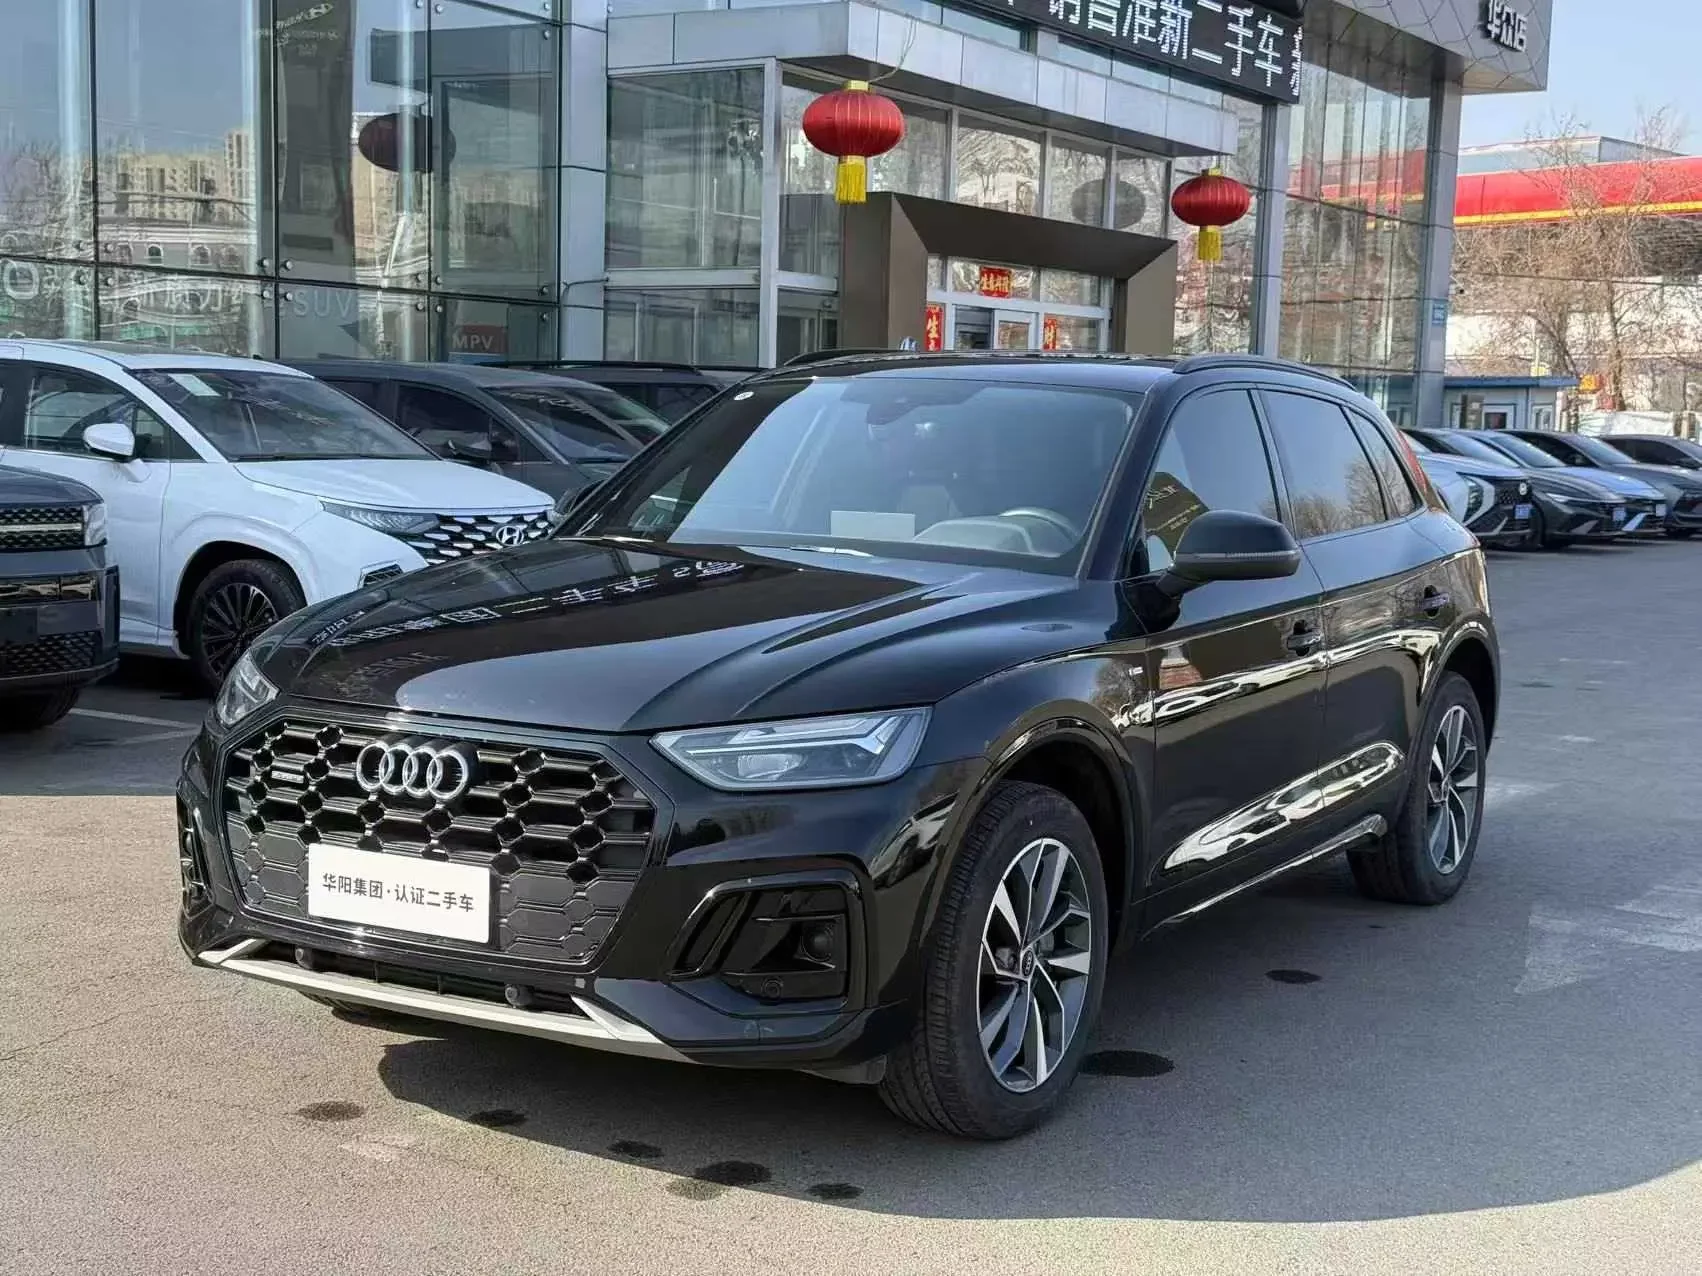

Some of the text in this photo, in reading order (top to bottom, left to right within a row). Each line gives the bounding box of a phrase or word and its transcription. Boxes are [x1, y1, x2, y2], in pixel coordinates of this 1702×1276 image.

[294, 284, 353, 317] SUV
[452, 334, 494, 350] MPV
[322, 872, 474, 913] 华阳集团·认证二手车
